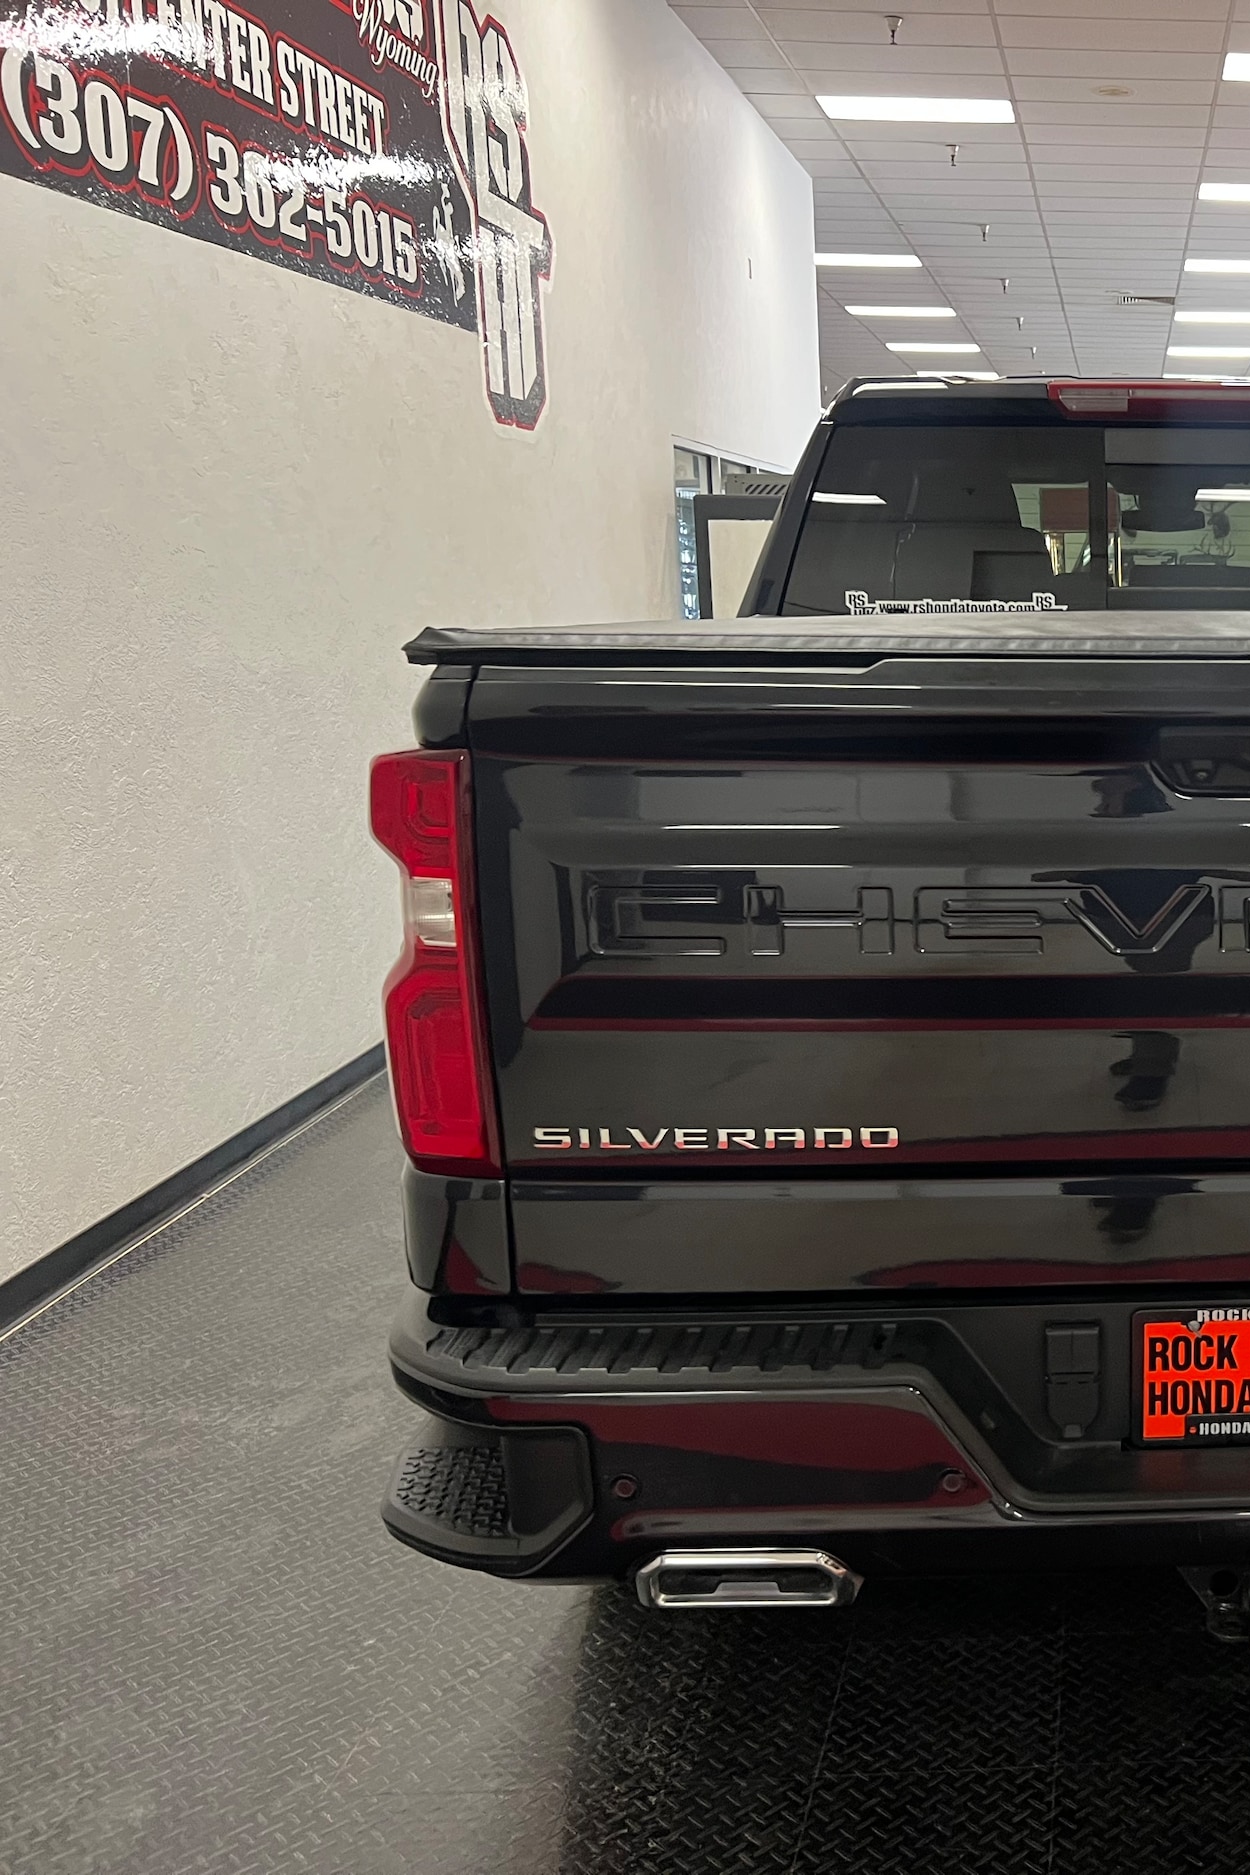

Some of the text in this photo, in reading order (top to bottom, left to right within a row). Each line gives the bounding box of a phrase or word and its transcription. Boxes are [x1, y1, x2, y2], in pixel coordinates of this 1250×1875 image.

[352, 0, 439, 98] Wyoming
[1, 46, 194, 200] (307)
[276, 40, 385, 157] STREET
[878, 600, 1036, 614] www.rshondatoyota.com
[533, 1126, 899, 1150] SILVERADO
[1148, 1334, 1238, 1372] ROCK
